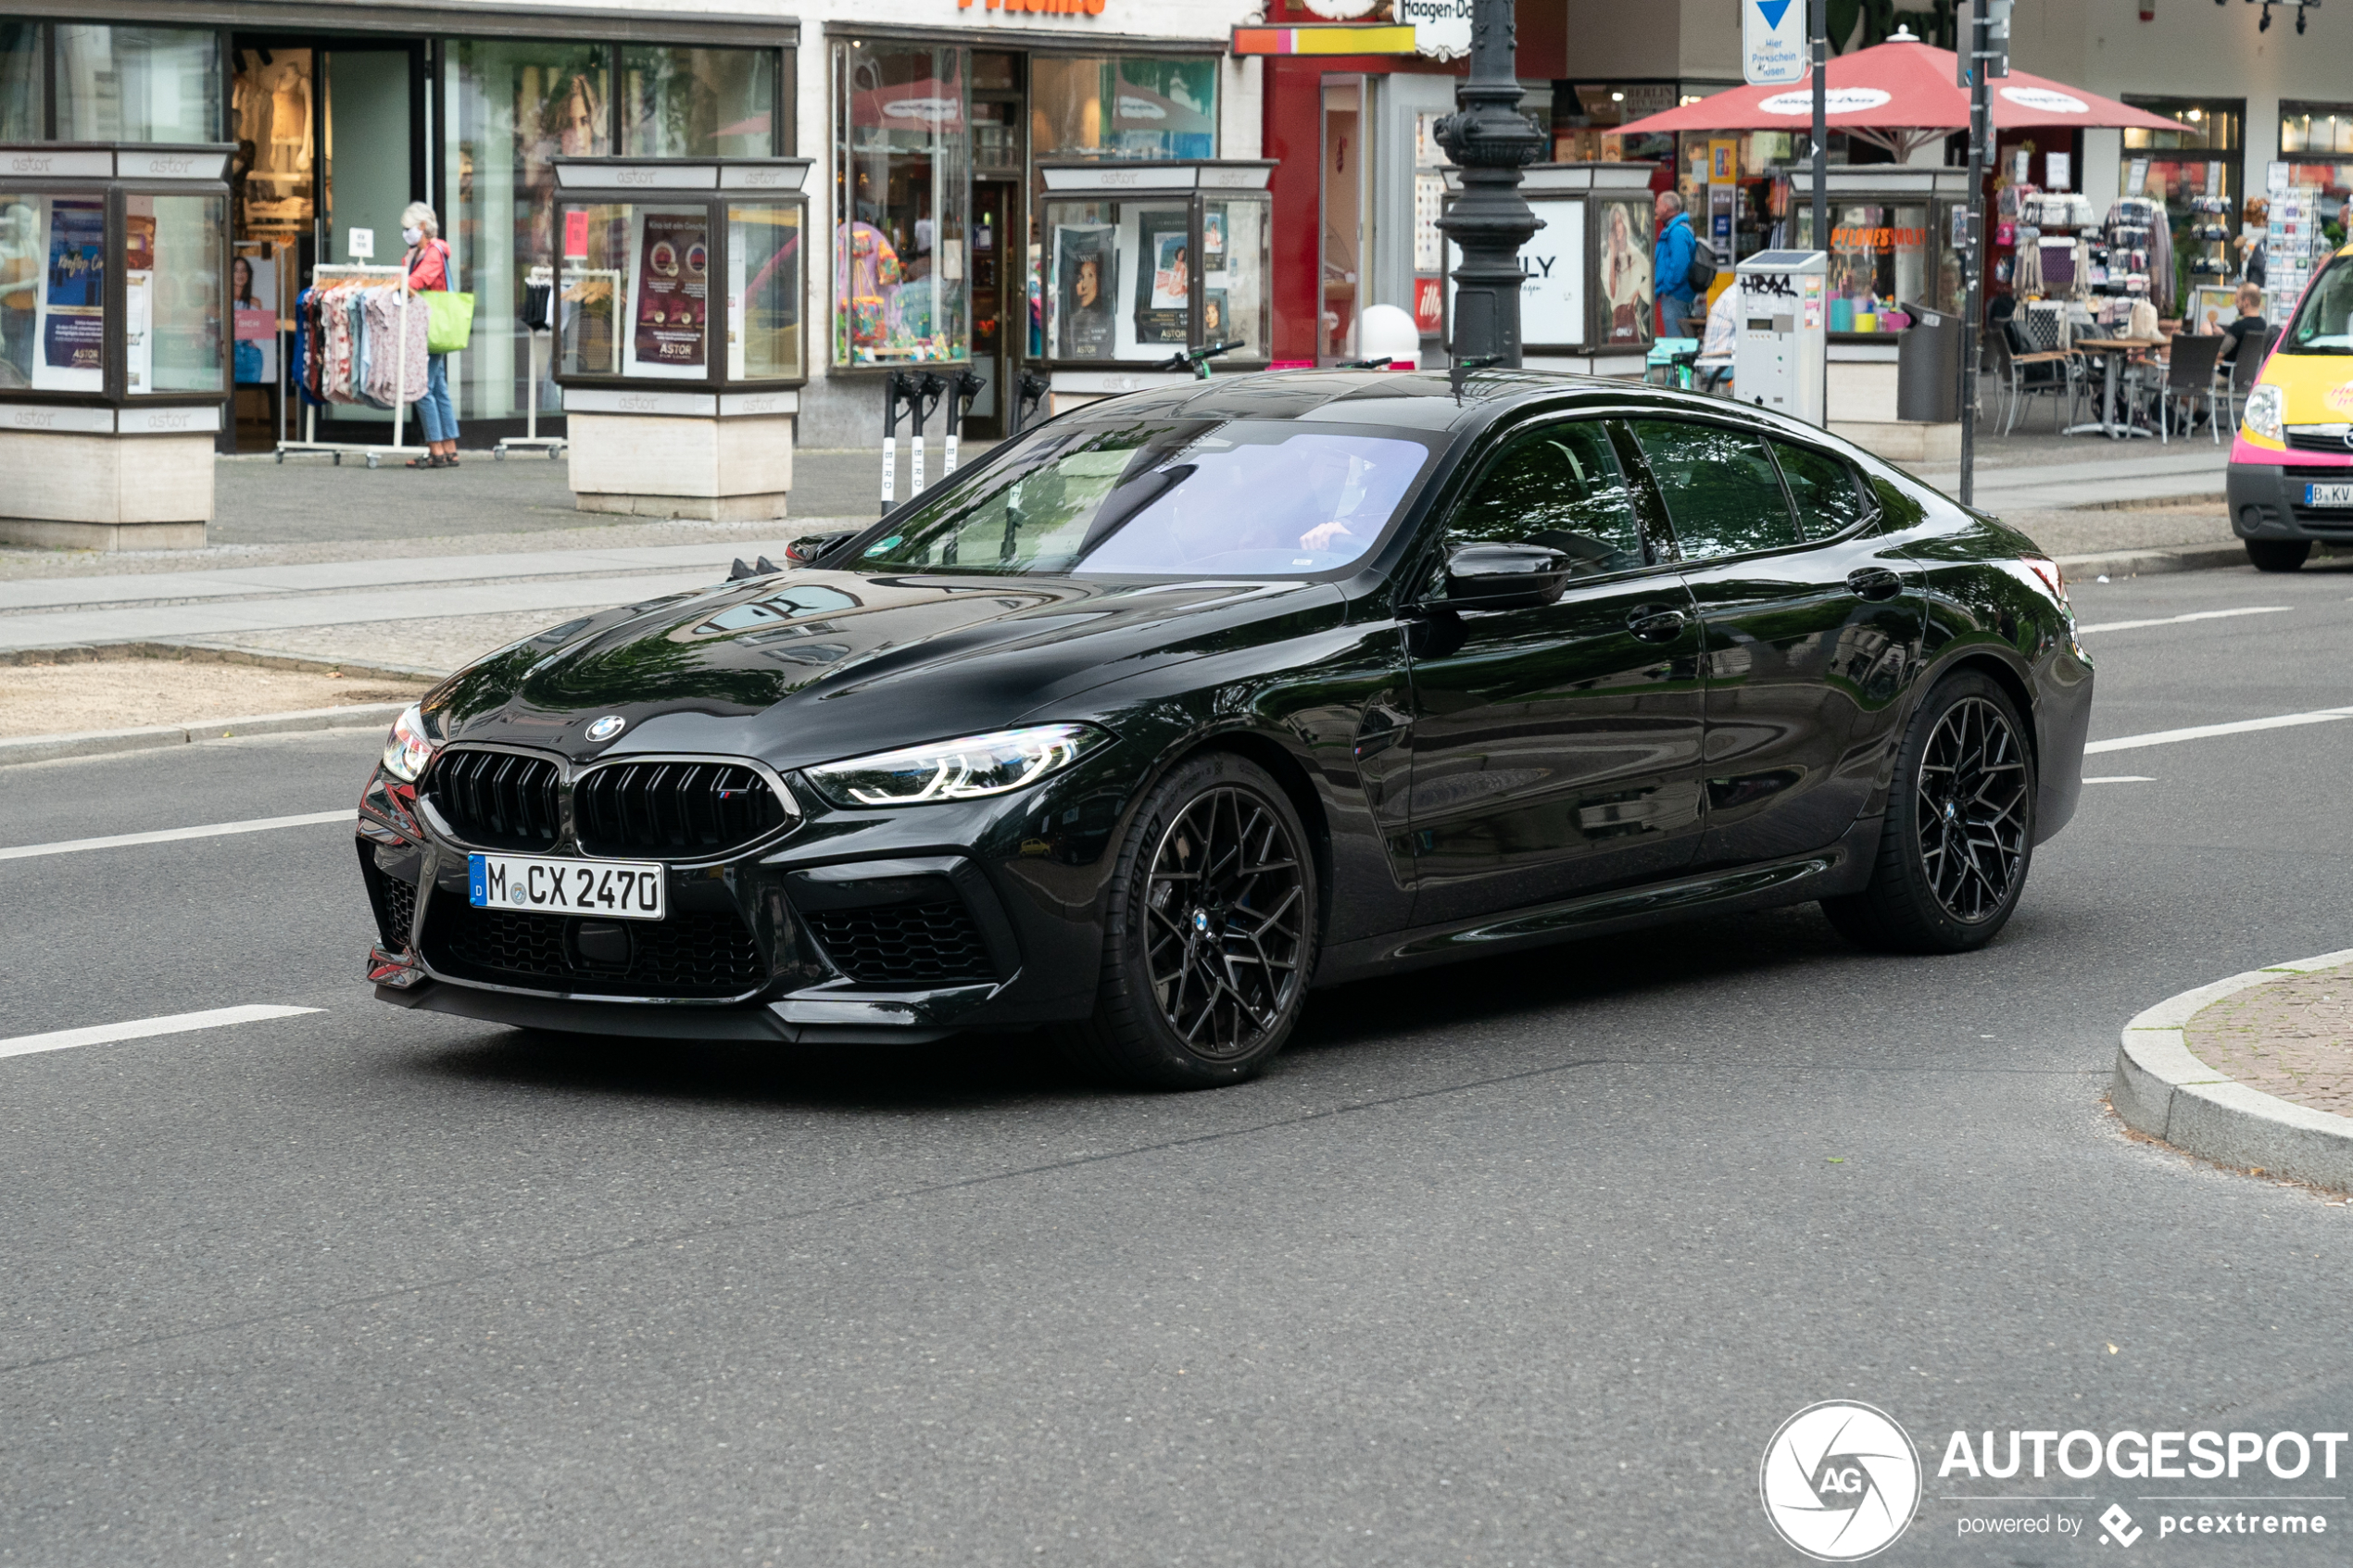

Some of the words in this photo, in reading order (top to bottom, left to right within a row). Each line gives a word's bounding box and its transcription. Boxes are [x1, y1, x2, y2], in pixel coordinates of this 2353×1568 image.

[1766, 39, 1782, 48] Hier
[11, 155, 52, 172] astor
[149, 156, 193, 174] astor
[617, 169, 657, 184] astor
[745, 170, 780, 184] astor
[1101, 170, 1139, 185] astor
[1219, 172, 1248, 185] astor
[1516, 256, 1556, 278] LY
[1161, 330, 1187, 339] ASTOR
[660, 343, 692, 355] ASTOR
[1076, 345, 1097, 355] ASTOR
[619, 395, 658, 410] astor
[742, 395, 775, 411] astor
[15, 408, 56, 426] astor
[148, 409, 192, 428] astor
[884, 451, 893, 489] BIRD
[914, 449, 923, 487] BIRD
[2314, 487, 2322, 501] B
[2332, 486, 2349, 501] KV
[487, 862, 507, 901] M
[528, 865, 568, 906] CX
[576, 868, 658, 911] 2470
